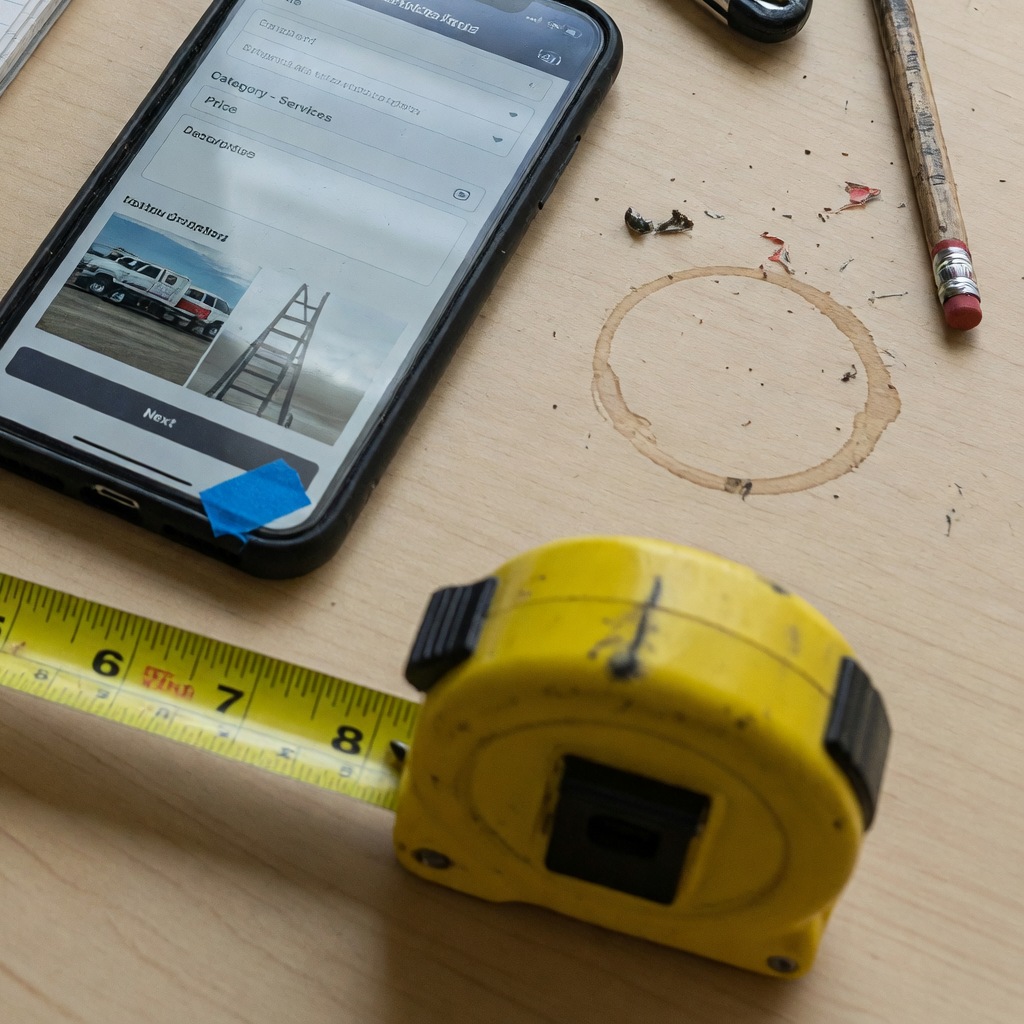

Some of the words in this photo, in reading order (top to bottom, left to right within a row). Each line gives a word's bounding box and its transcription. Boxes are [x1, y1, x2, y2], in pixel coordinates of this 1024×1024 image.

[203, 94, 239, 115] Price
[210, 70, 269, 101] Category
[278, 95, 334, 124] Services
[142, 407, 178, 429] Next
[92, 649, 125, 677] 6
[215, 683, 245, 714] 7
[331, 725, 364, 756] 8
